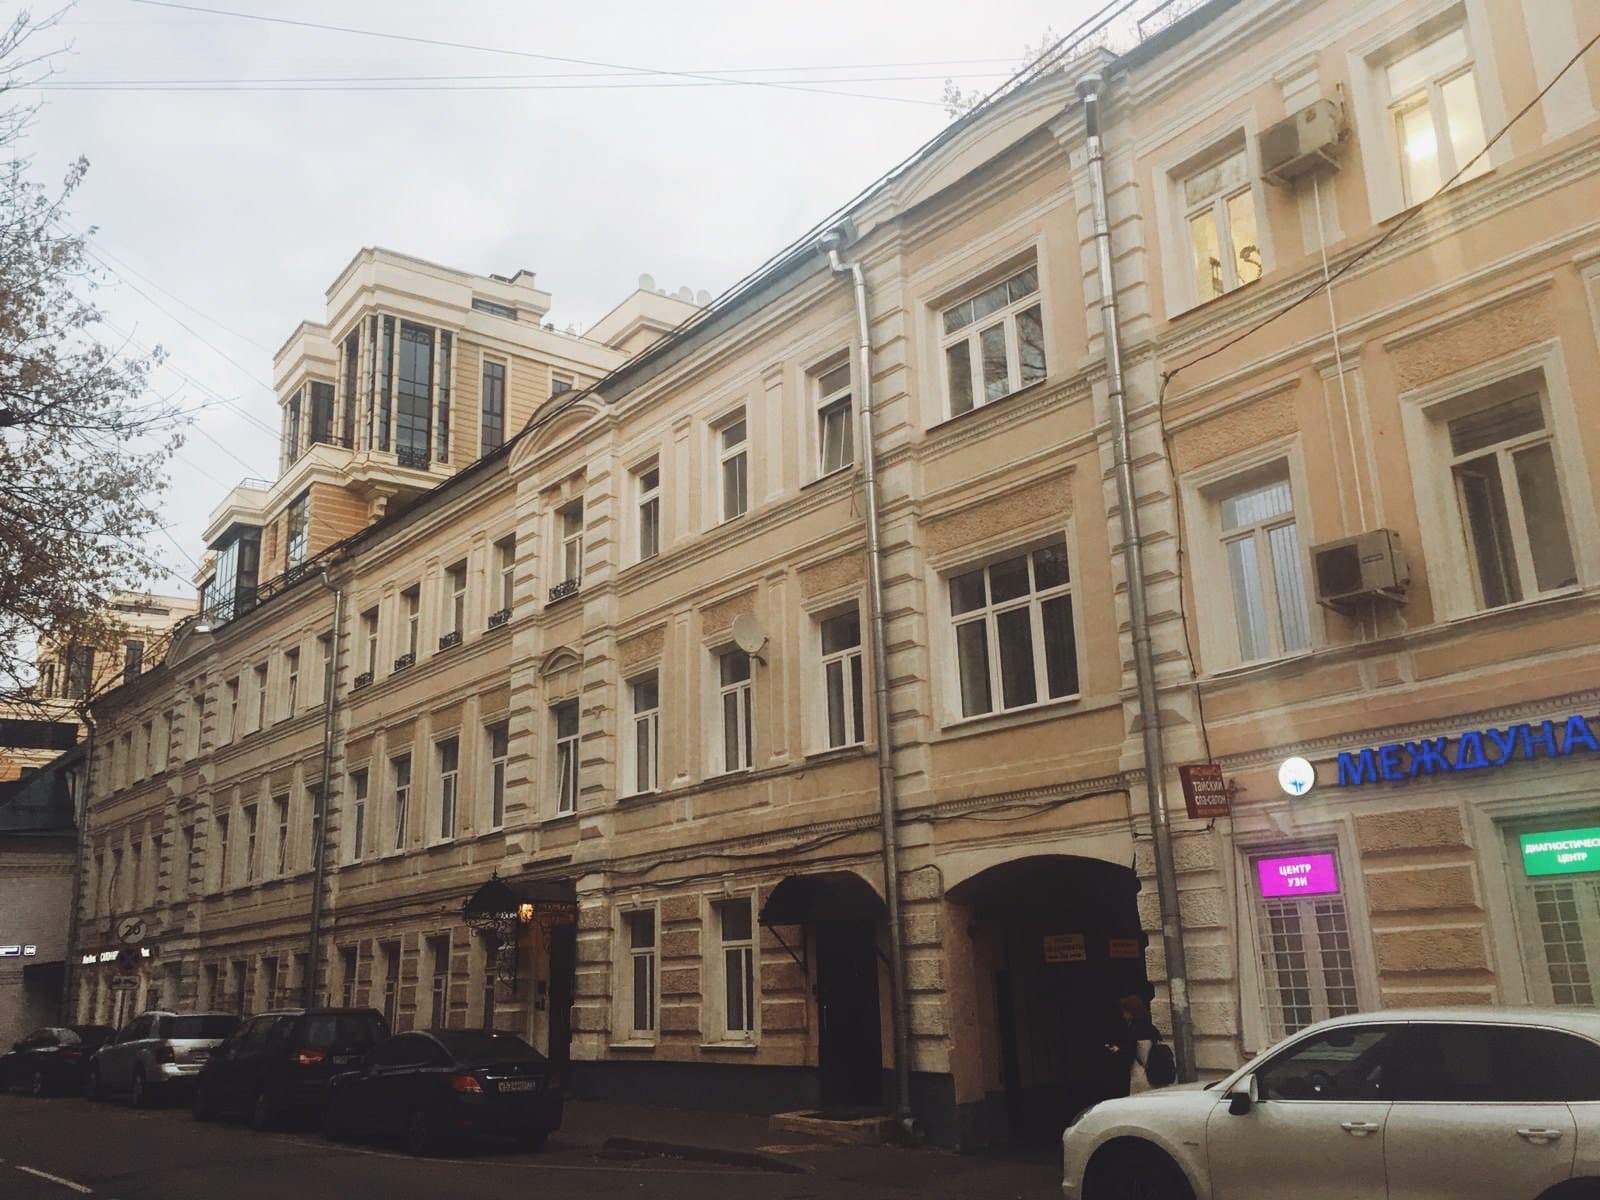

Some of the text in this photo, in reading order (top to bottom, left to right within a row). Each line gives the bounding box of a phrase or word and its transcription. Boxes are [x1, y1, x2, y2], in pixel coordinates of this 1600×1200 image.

[1337, 714, 1600, 787] МЕЖДУНА
[1557, 852, 1588, 864] ЦЕНТР
[1279, 863, 1312, 877] ЦЕНТР
[1287, 876, 1308, 888] УЗИ
